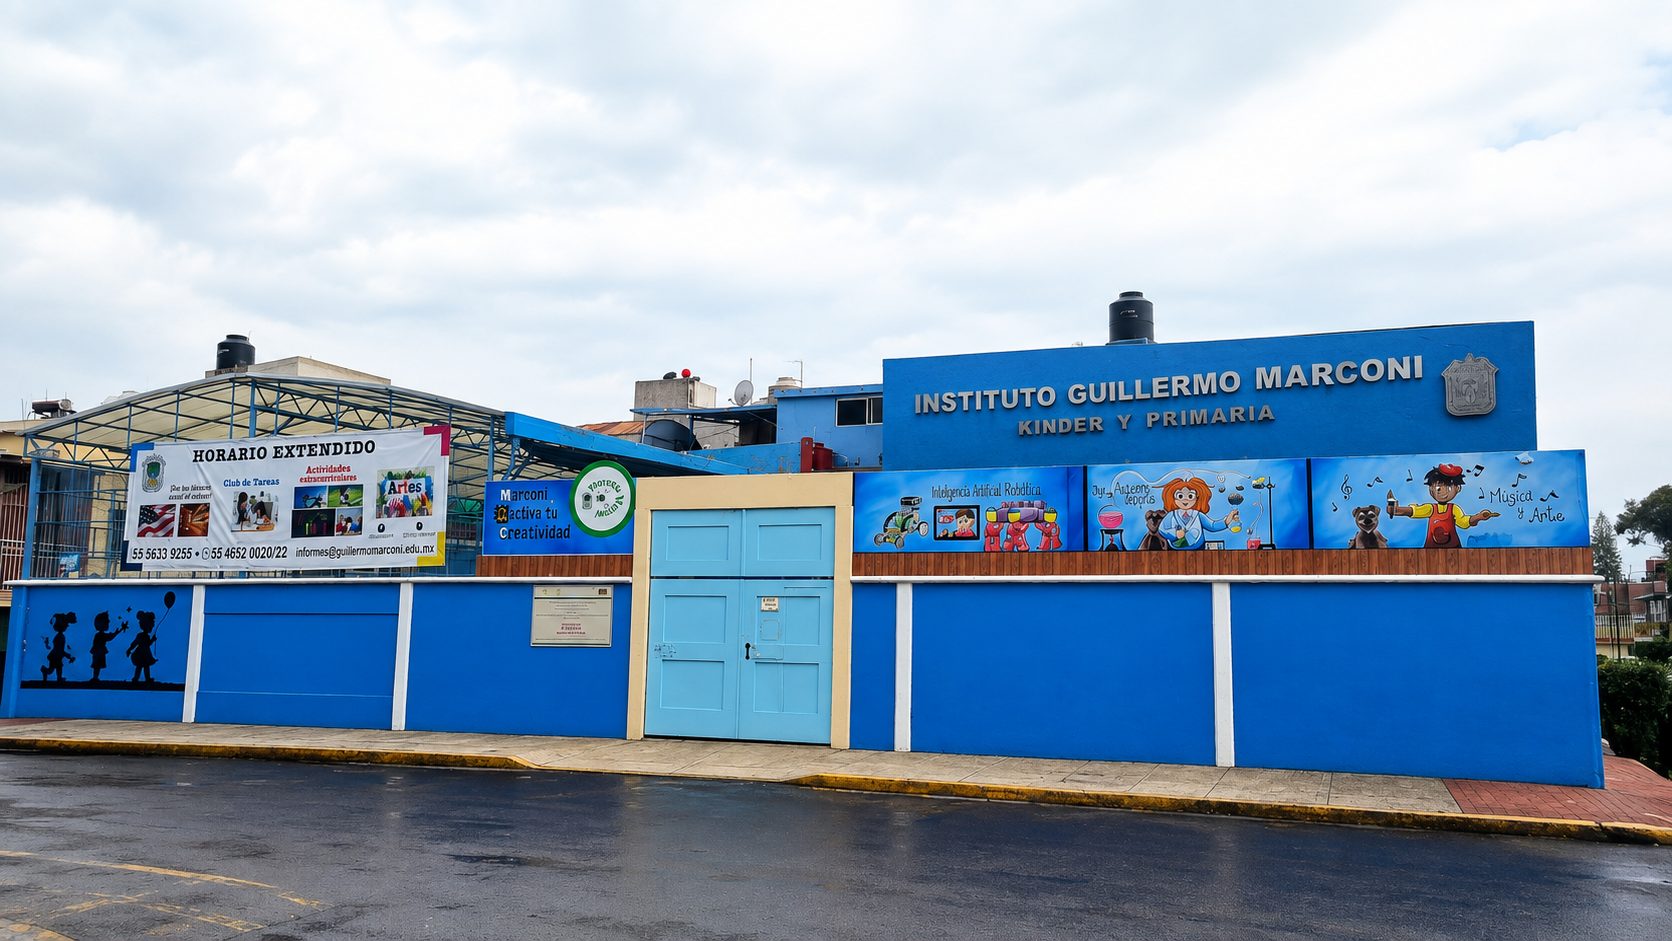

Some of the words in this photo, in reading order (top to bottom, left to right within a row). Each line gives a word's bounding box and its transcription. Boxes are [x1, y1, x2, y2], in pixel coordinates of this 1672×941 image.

[914, 386, 1057, 415] INSTITUTO
[1067, 370, 1242, 405] GUILLERMO
[1255, 354, 1424, 391] MARCONI
[1017, 415, 1104, 436] KINDER
[1117, 413, 1133, 431] Y
[1146, 404, 1276, 428] PRIMARIA
[192, 446, 268, 463] HORARIO
[272, 440, 376, 460] EXTENDIDO
[306, 464, 351, 475] Actividades
[223, 479, 241, 487] Club
[242, 478, 252, 487] de
[253, 478, 280, 486] Tareas
[387, 481, 422, 495] Artes
[500, 488, 548, 502] Marconi
[545, 507, 558, 519] tu
[1517, 507, 1524, 519] y
[1529, 505, 1565, 523] Arte
[499, 525, 571, 540] Creatividad
[131, 548, 143, 560] 55
[145, 548, 168, 560] 5633
[170, 547, 193, 560] 9255
[210, 548, 222, 559] 55
[224, 547, 247, 559] 4652
[249, 546, 288, 558] 0020/22
